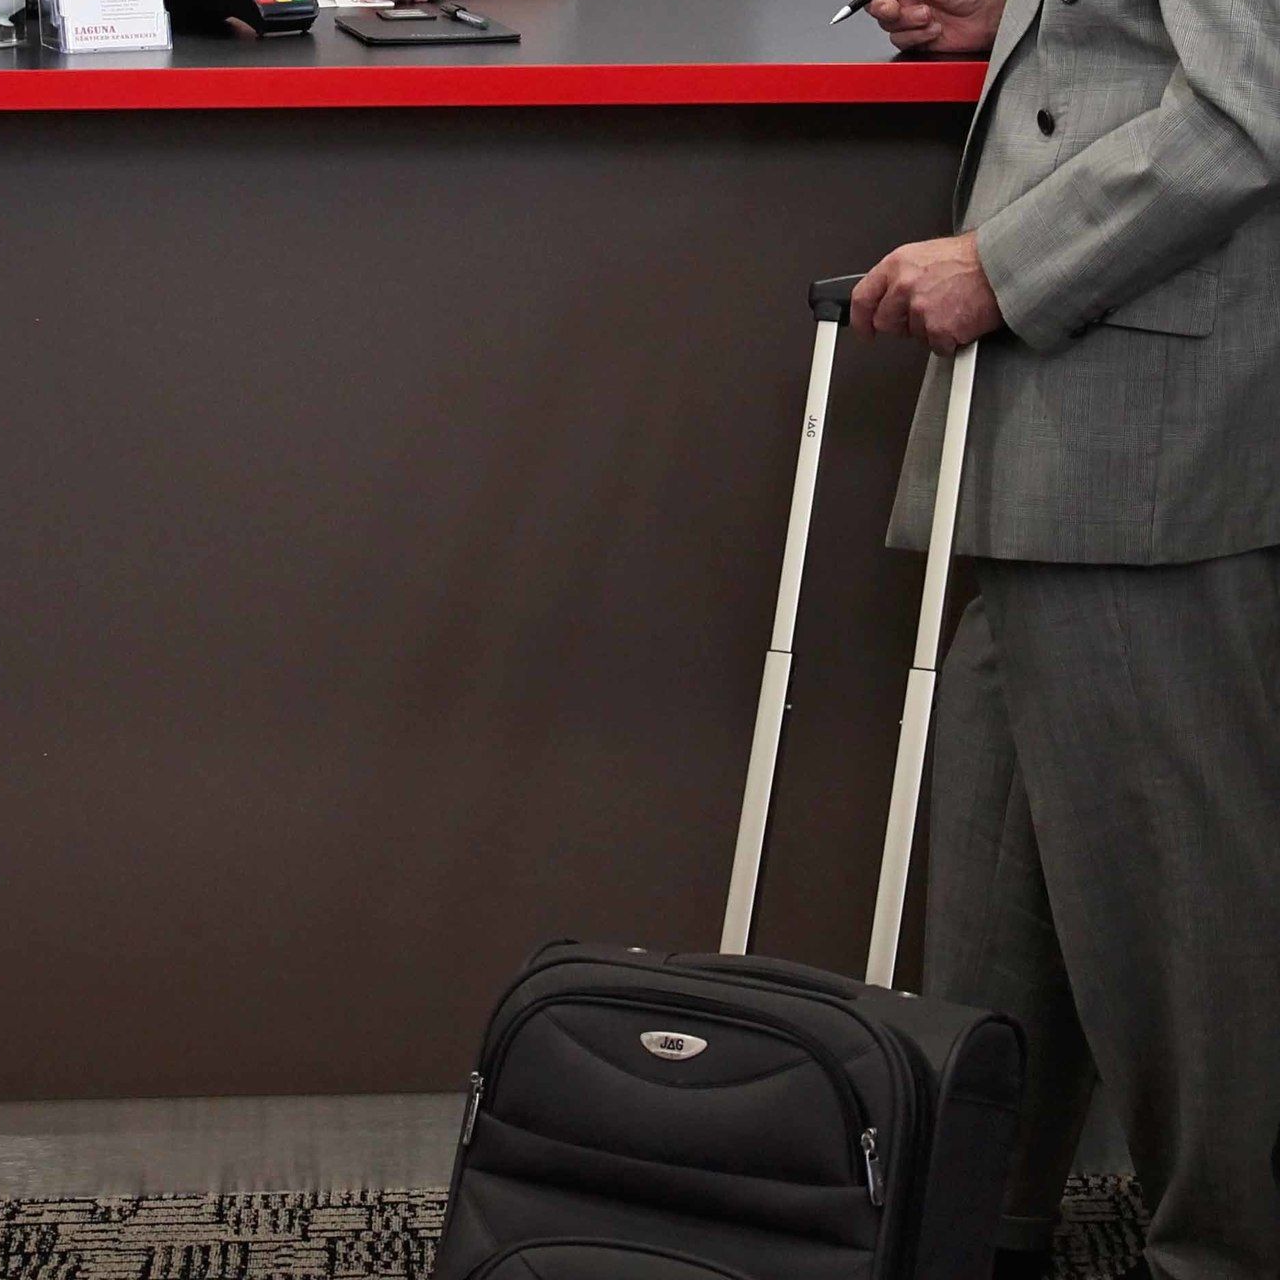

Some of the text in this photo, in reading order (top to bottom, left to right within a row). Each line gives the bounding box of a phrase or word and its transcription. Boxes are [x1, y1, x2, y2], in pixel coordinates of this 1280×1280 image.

[74, 25, 116, 35] LAGUNA
[806, 414, 817, 438] JAG
[660, 1036, 684, 1051] JAG
